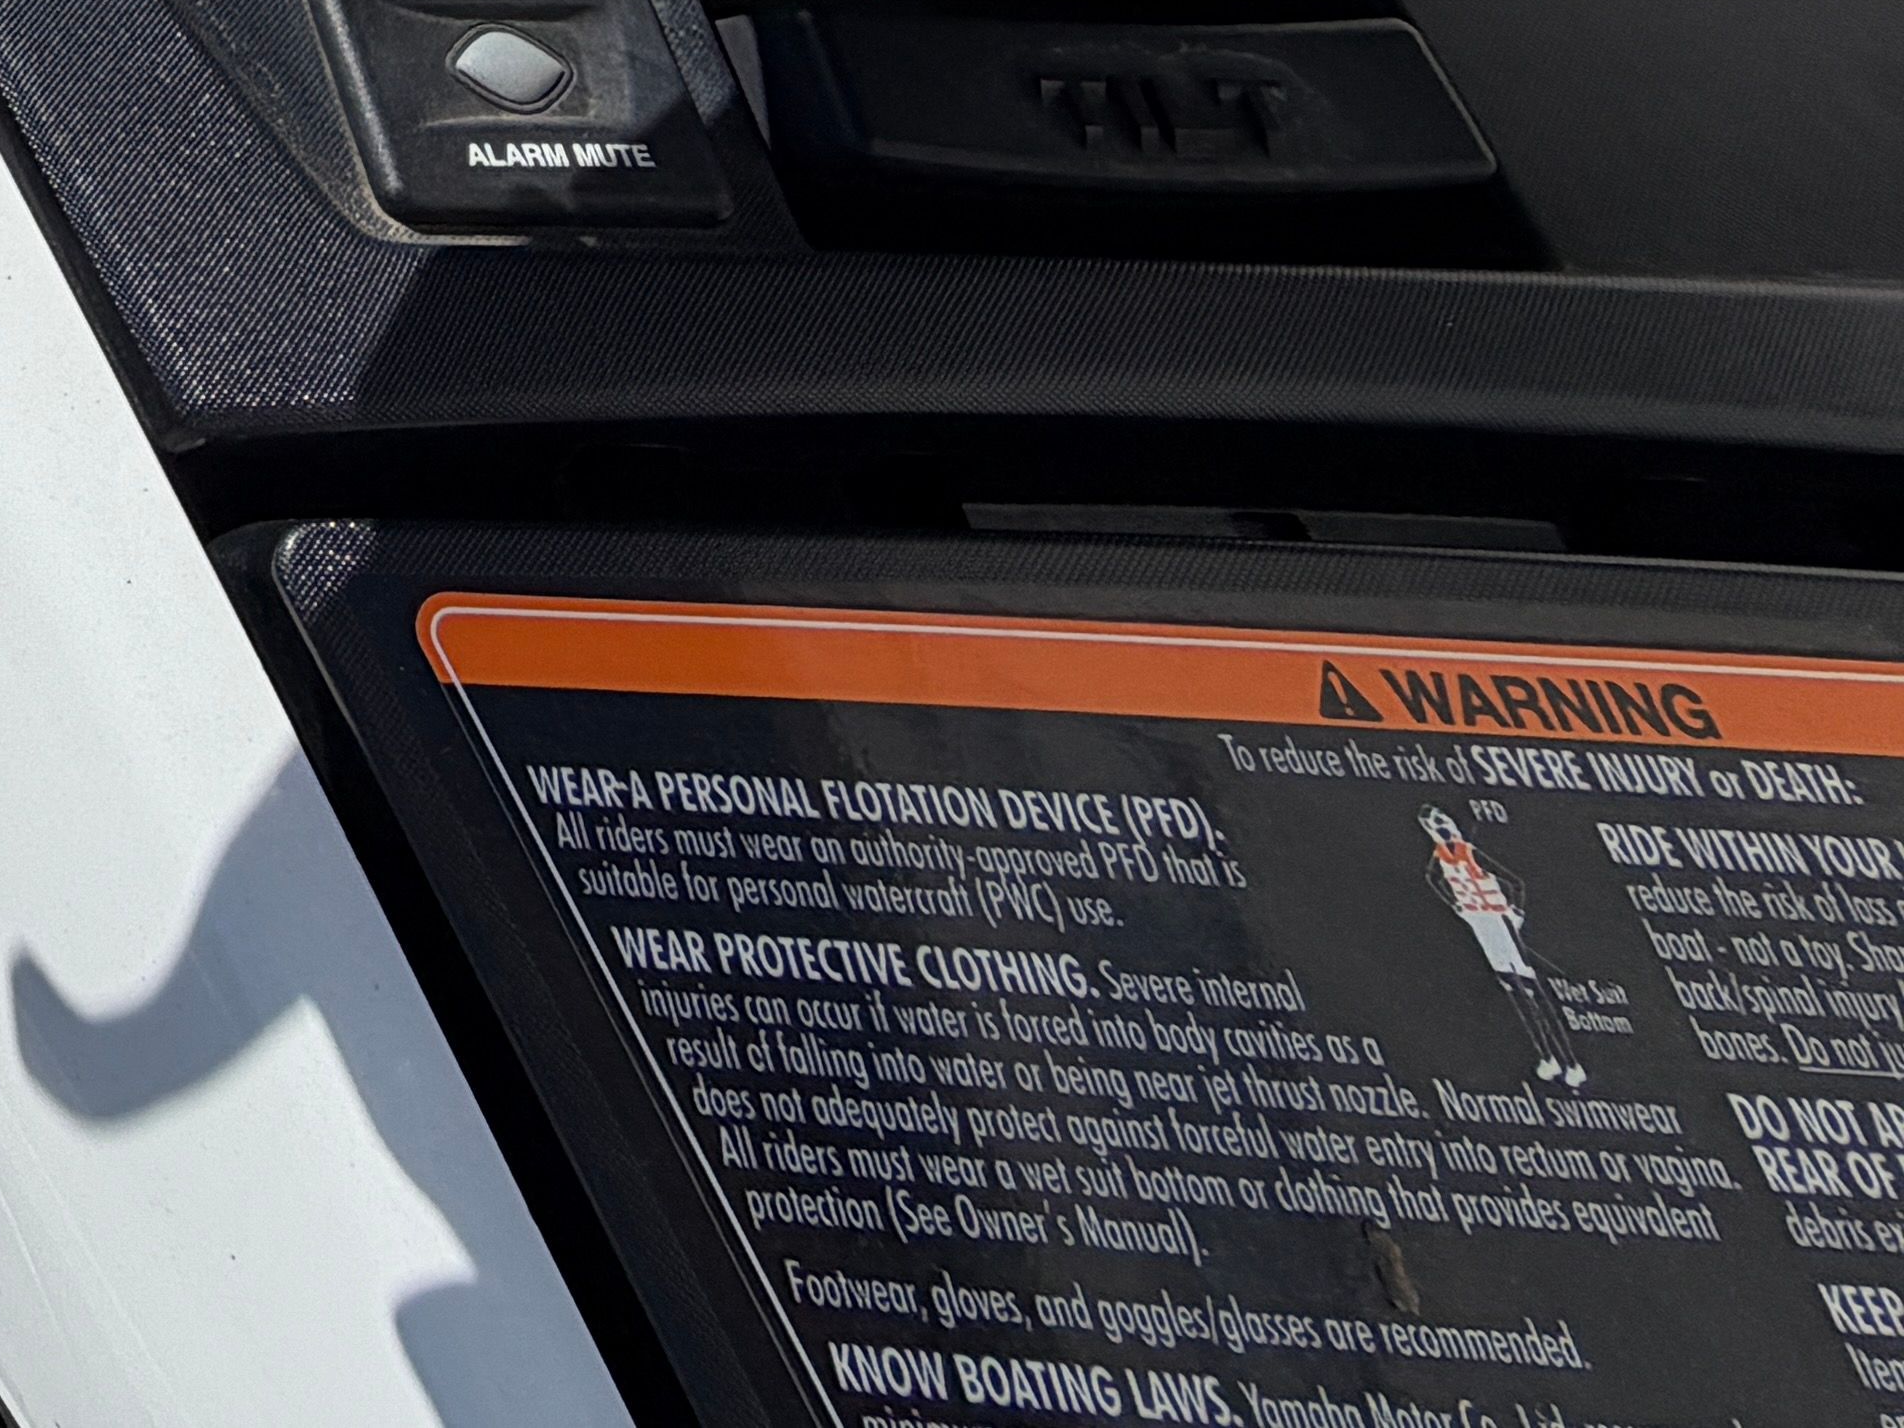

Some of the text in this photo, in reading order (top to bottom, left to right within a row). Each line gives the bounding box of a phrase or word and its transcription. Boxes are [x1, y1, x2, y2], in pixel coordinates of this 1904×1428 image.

[468, 142, 657, 168] ALARM MUTE
[1379, 668, 1723, 741] WARNING
[1217, 733, 1865, 805] To reduce the risk of SEVERE INJURY or DEATH:
[655, 770, 822, 820] PERSONAL
[821, 779, 998, 829] FLOTATION
[998, 789, 1121, 834] DEVICE
[1120, 794, 1226, 851] (PFD).
[556, 812, 1247, 888] All riders must wear an authority-approved PFD that is
[1596, 822, 1903, 880] RIDE WITHIN YOUR
[579, 858, 1124, 933] suitable for personal watercraft (PWC) use.
[1626, 873, 1899, 926] reduce the risk of loss
[610, 926, 1307, 1011] WEAR PROTECTIVE CLOTHING. Severe internal
[1642, 918, 1713, 962] boat
[1731, 931, 1779, 966] not
[1779, 939, 1803, 967] a
[1798, 934, 1855, 979] toy.
[637, 979, 1385, 1066] injuries can occur if water is forced into body cavities as a
[1562, 1006, 1634, 1034] Bottom
[1664, 965, 1904, 1032] back/spinal injury
[1689, 1015, 1789, 1063] bones.
[1780, 1023, 1830, 1066] Do
[1830, 1034, 1879, 1068] not
[665, 1026, 1683, 1135] result of falling into water or being near jet thrust nozzle. Normal swimwear
[692, 1073, 1742, 1198] does not adequately protect against forceful water entry into rectum or vagina.
[1726, 1093, 1791, 1142] DO
[1786, 1096, 1868, 1146] NOT
[719, 1126, 1722, 1245] All riders must wear a wet suit bottom or clothing that provides equivalent
[1751, 1145, 1898, 1200] REAR OF
[745, 1185, 885, 1231] protection
[885, 1185, 953, 1243] (See
[1074, 1203, 1210, 1267] Manual).
[1785, 1199, 1876, 1252] debris
[783, 1258, 1591, 1370] Footwear, gloves, and goggles/glasses are recommended.
[1816, 1283, 1904, 1336] KEEP
[828, 1342, 948, 1400] KNOW
[953, 1353, 1121, 1418] BOATING
[1124, 1368, 1243, 1428] LAWS.
